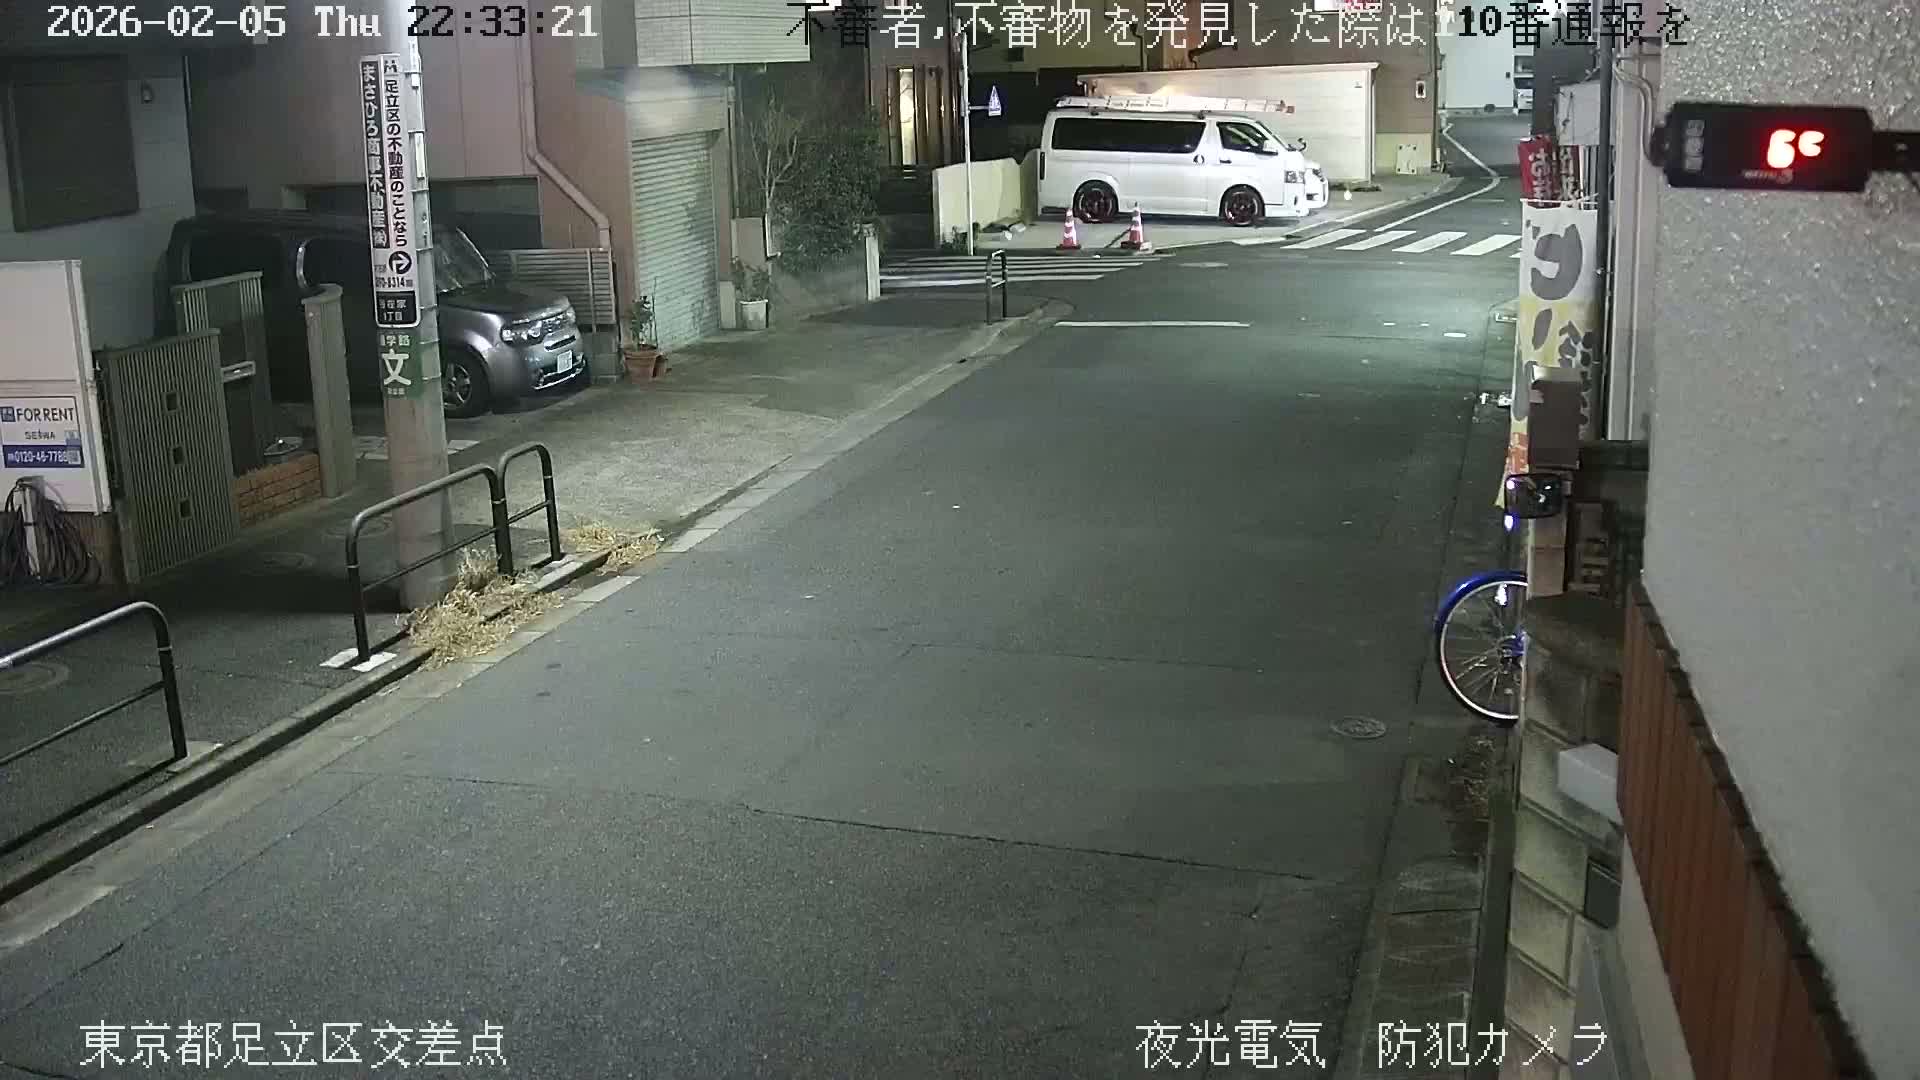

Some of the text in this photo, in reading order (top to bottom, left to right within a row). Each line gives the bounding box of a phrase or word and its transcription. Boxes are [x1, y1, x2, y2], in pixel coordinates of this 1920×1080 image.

[385, 79, 407, 247] 足立区の不動産のことなら
[382, 348, 412, 385] 文
[17, 408, 41, 422] FOR
[43, 407, 74, 421] RENT
